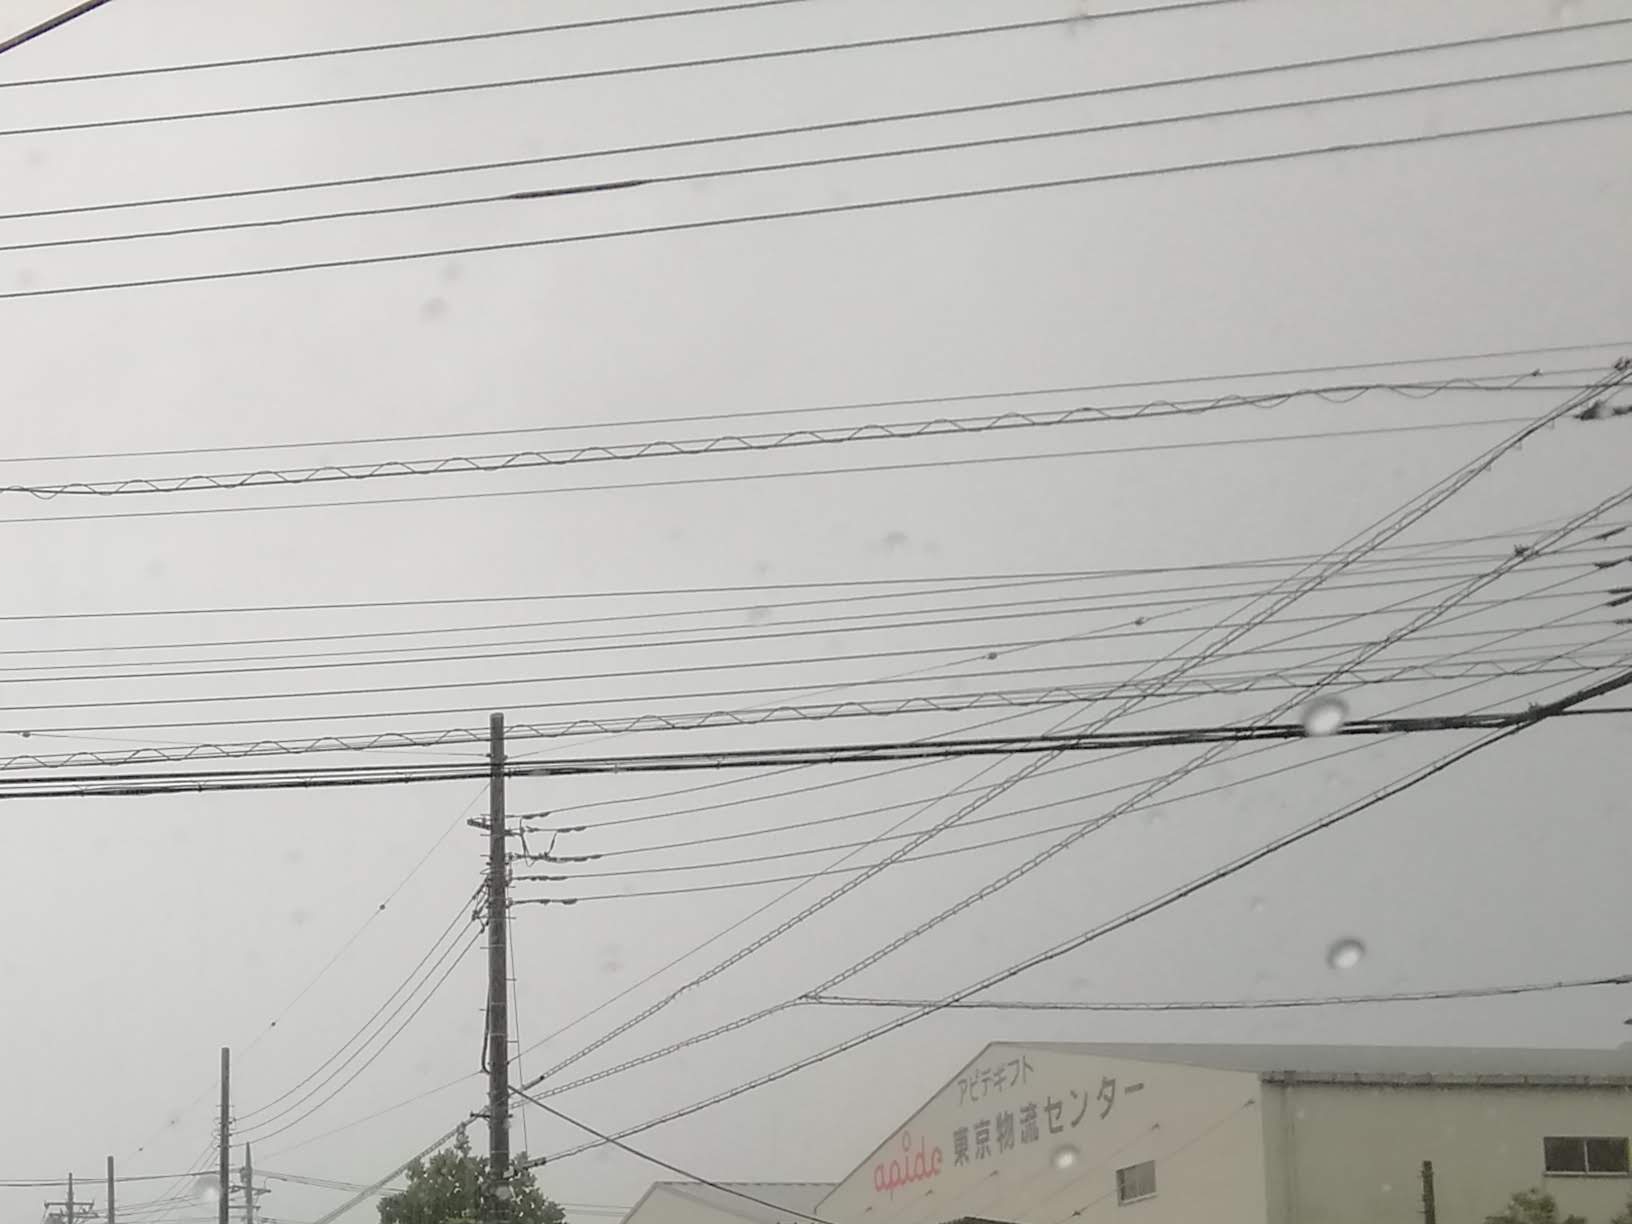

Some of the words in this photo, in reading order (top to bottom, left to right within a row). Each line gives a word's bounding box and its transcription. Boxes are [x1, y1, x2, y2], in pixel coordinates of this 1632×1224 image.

[952, 1075, 1145, 1167] 東京物流センター
[873, 1130, 944, 1201] apide
